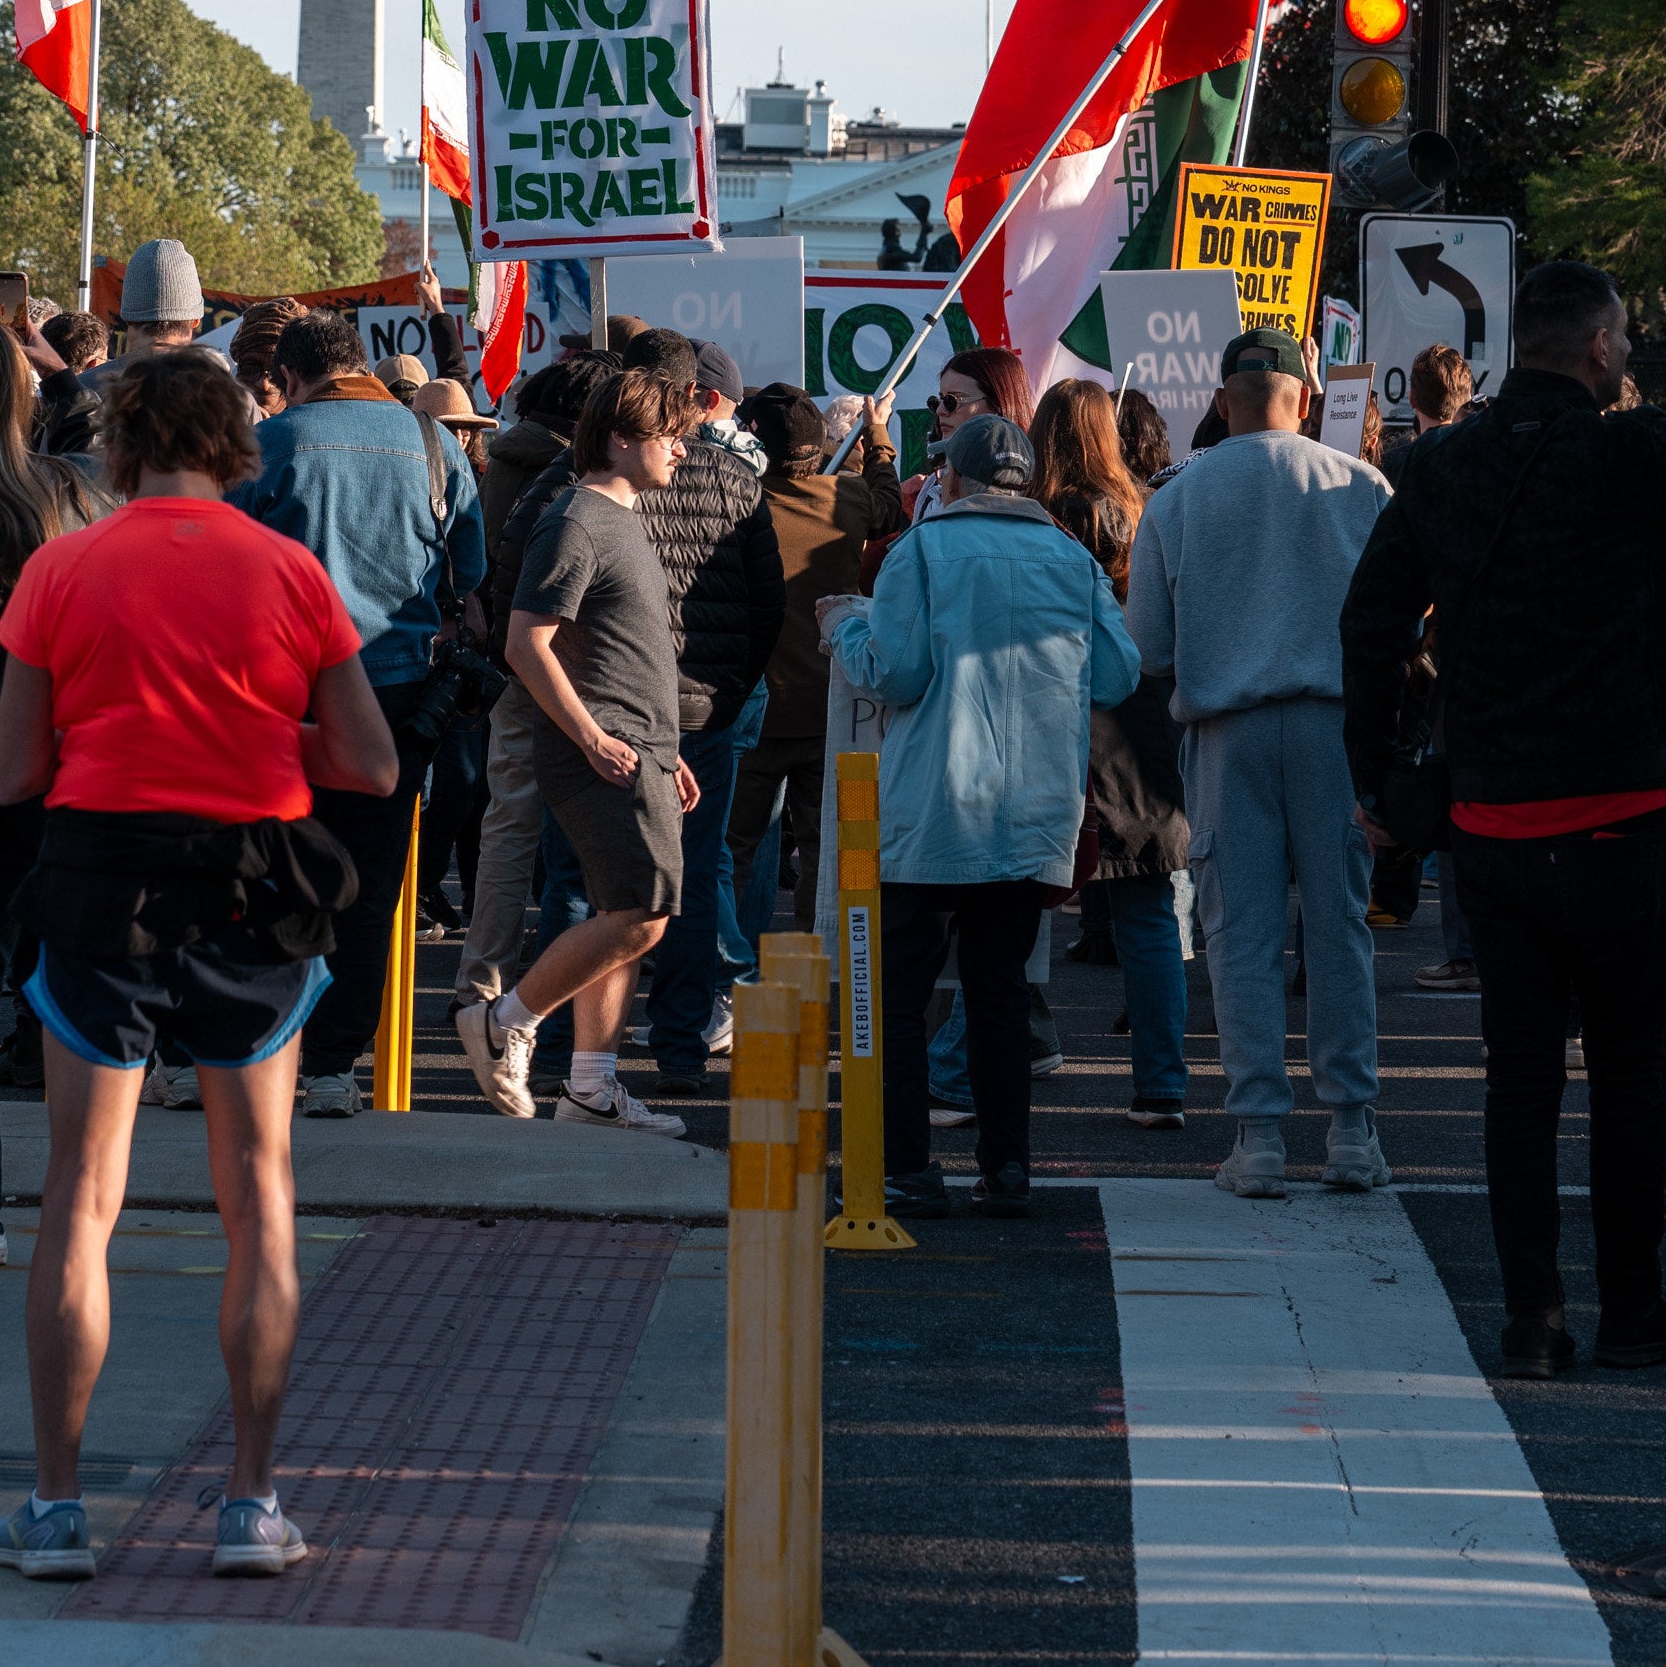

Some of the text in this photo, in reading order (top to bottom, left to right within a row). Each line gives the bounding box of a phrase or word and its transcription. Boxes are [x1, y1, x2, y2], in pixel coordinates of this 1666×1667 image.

[483, 32, 693, 118] WAR
[493, 159, 696, 227] ISRAEL
[1191, 192, 1318, 223] WAR CRIMES
[1242, 183, 1291, 195] NO KINGS
[1199, 224, 1301, 270] DO NOT
[1333, 320, 1353, 364] NO
[1330, 409, 1357, 421] Resistance
[1333, 391, 1358, 404] Long Live
[850, 912, 870, 1051] AKEBOFFICIAL.COM
